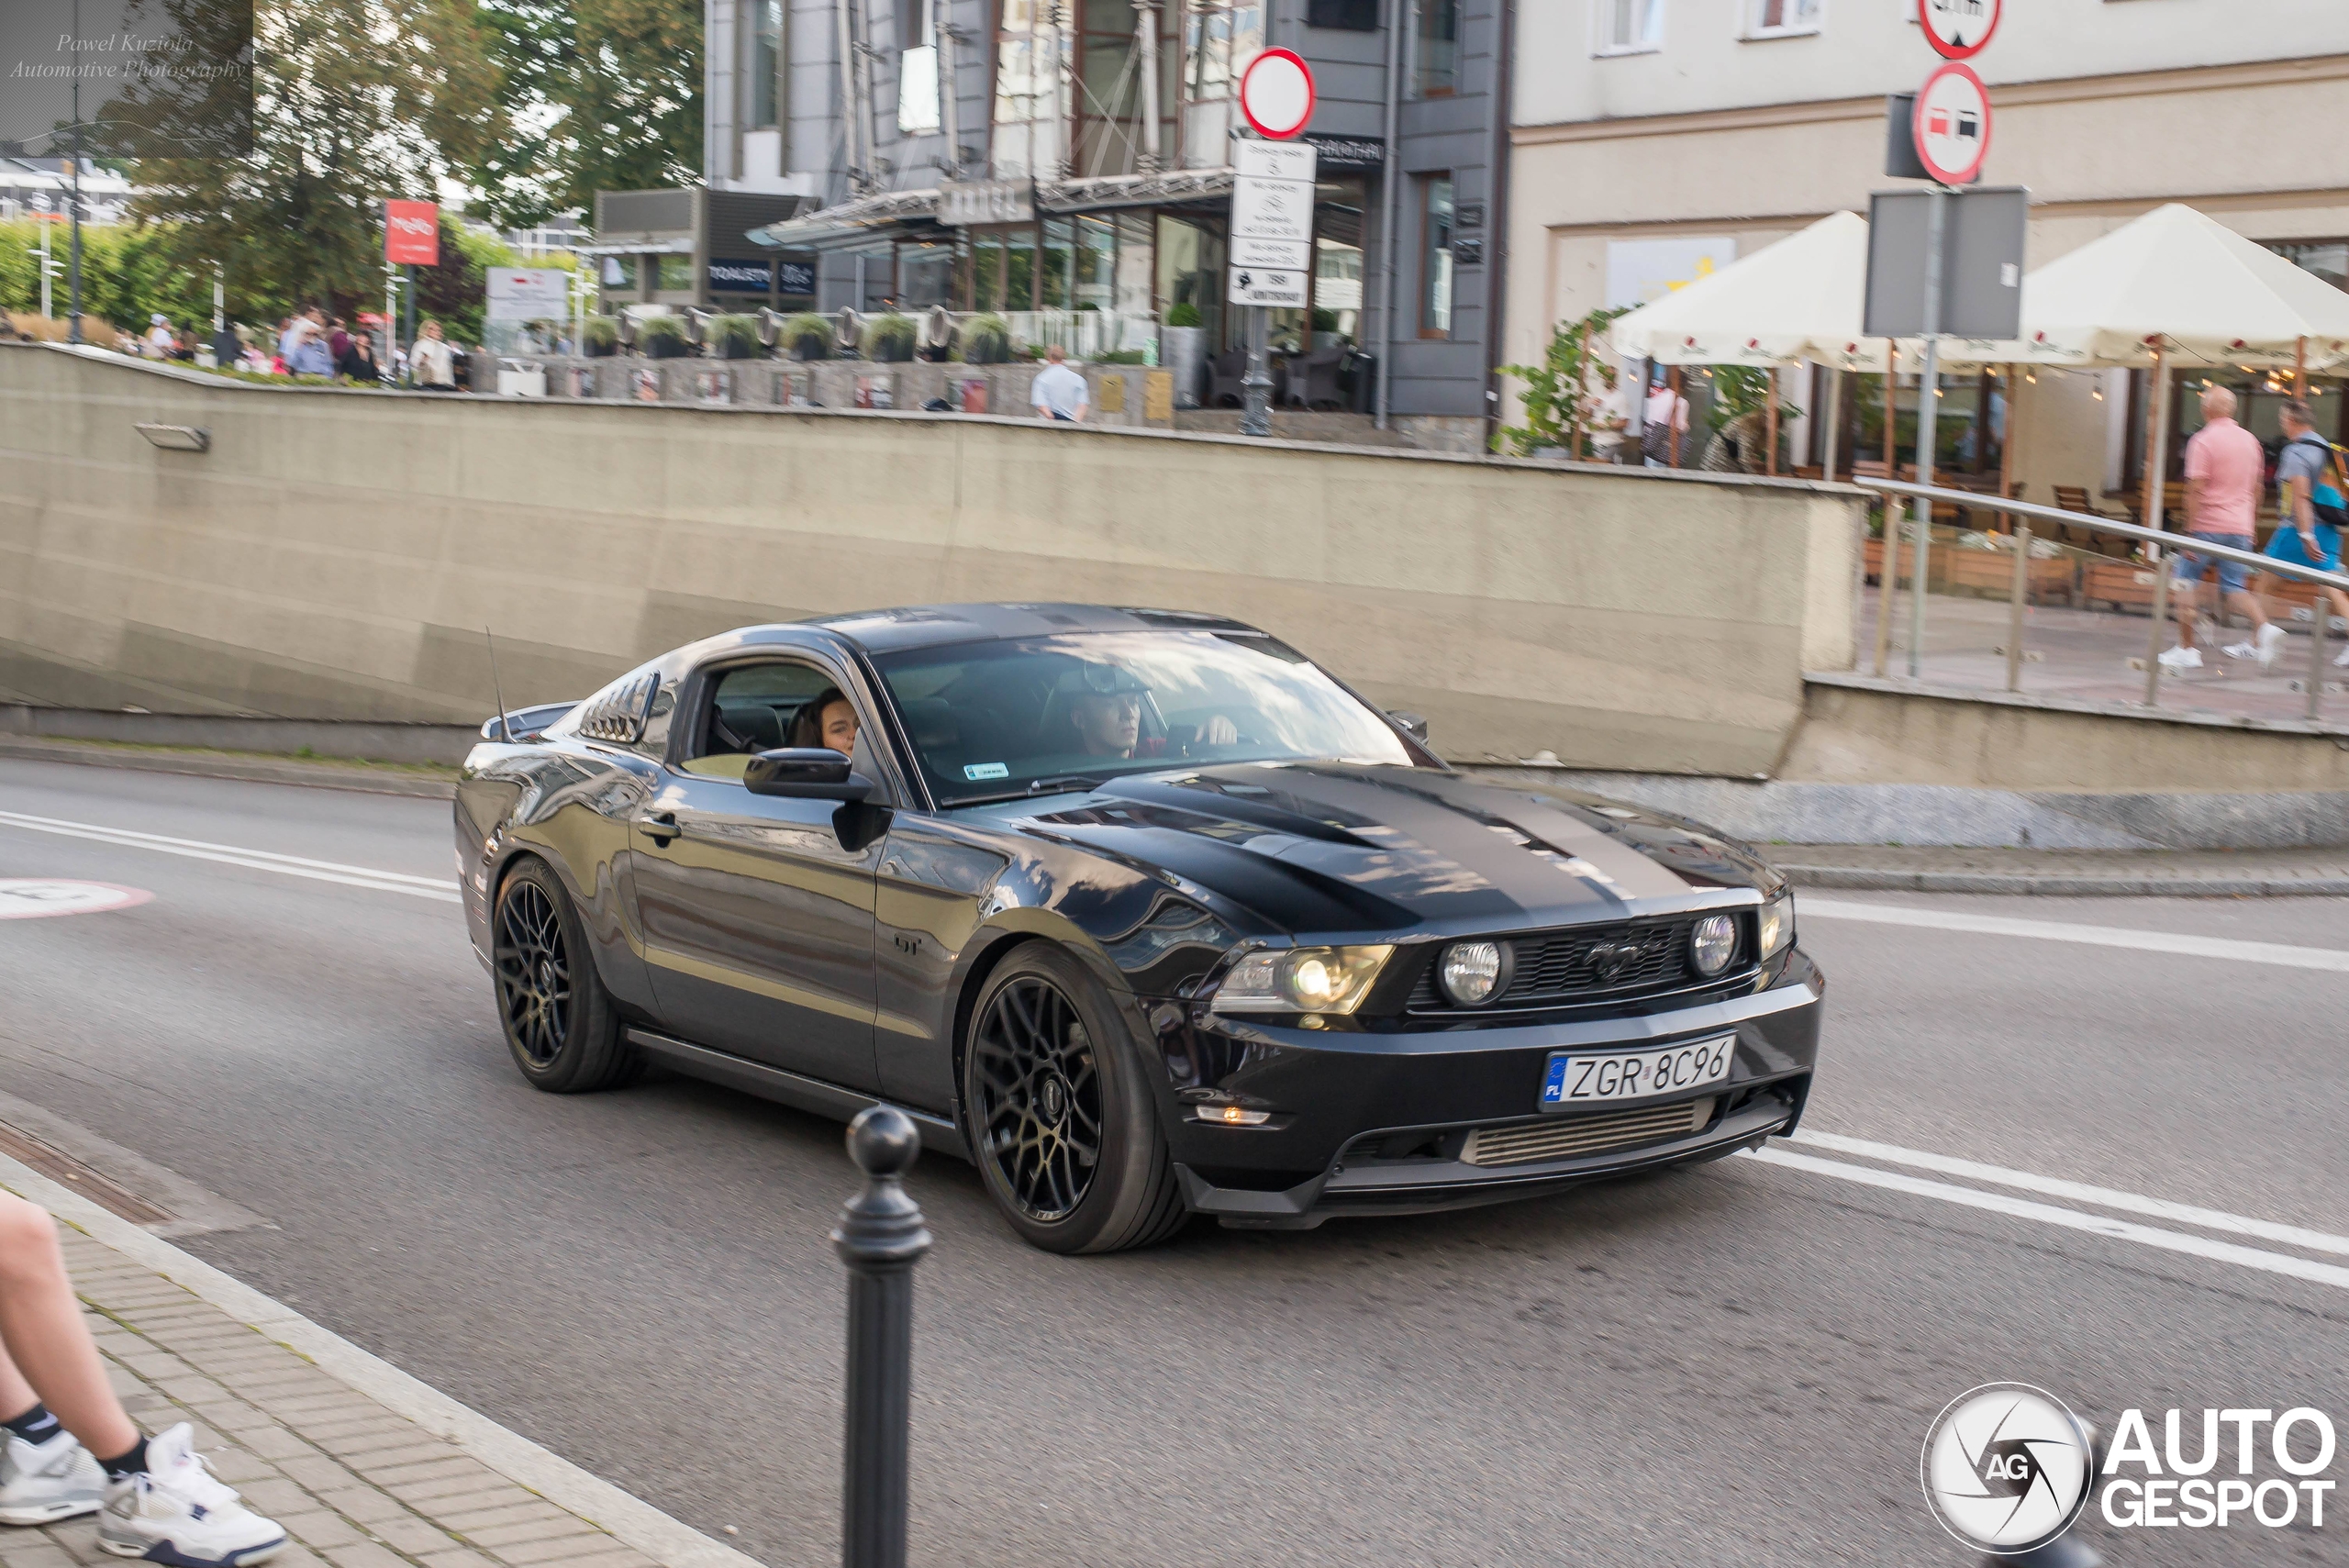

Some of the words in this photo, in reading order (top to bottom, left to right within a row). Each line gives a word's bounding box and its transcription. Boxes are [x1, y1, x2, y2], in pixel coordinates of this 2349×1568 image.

[1569, 1057, 1642, 1098] ZGR
[1653, 1040, 1730, 1091] 8C96
[1545, 1084, 1561, 1097] PL
